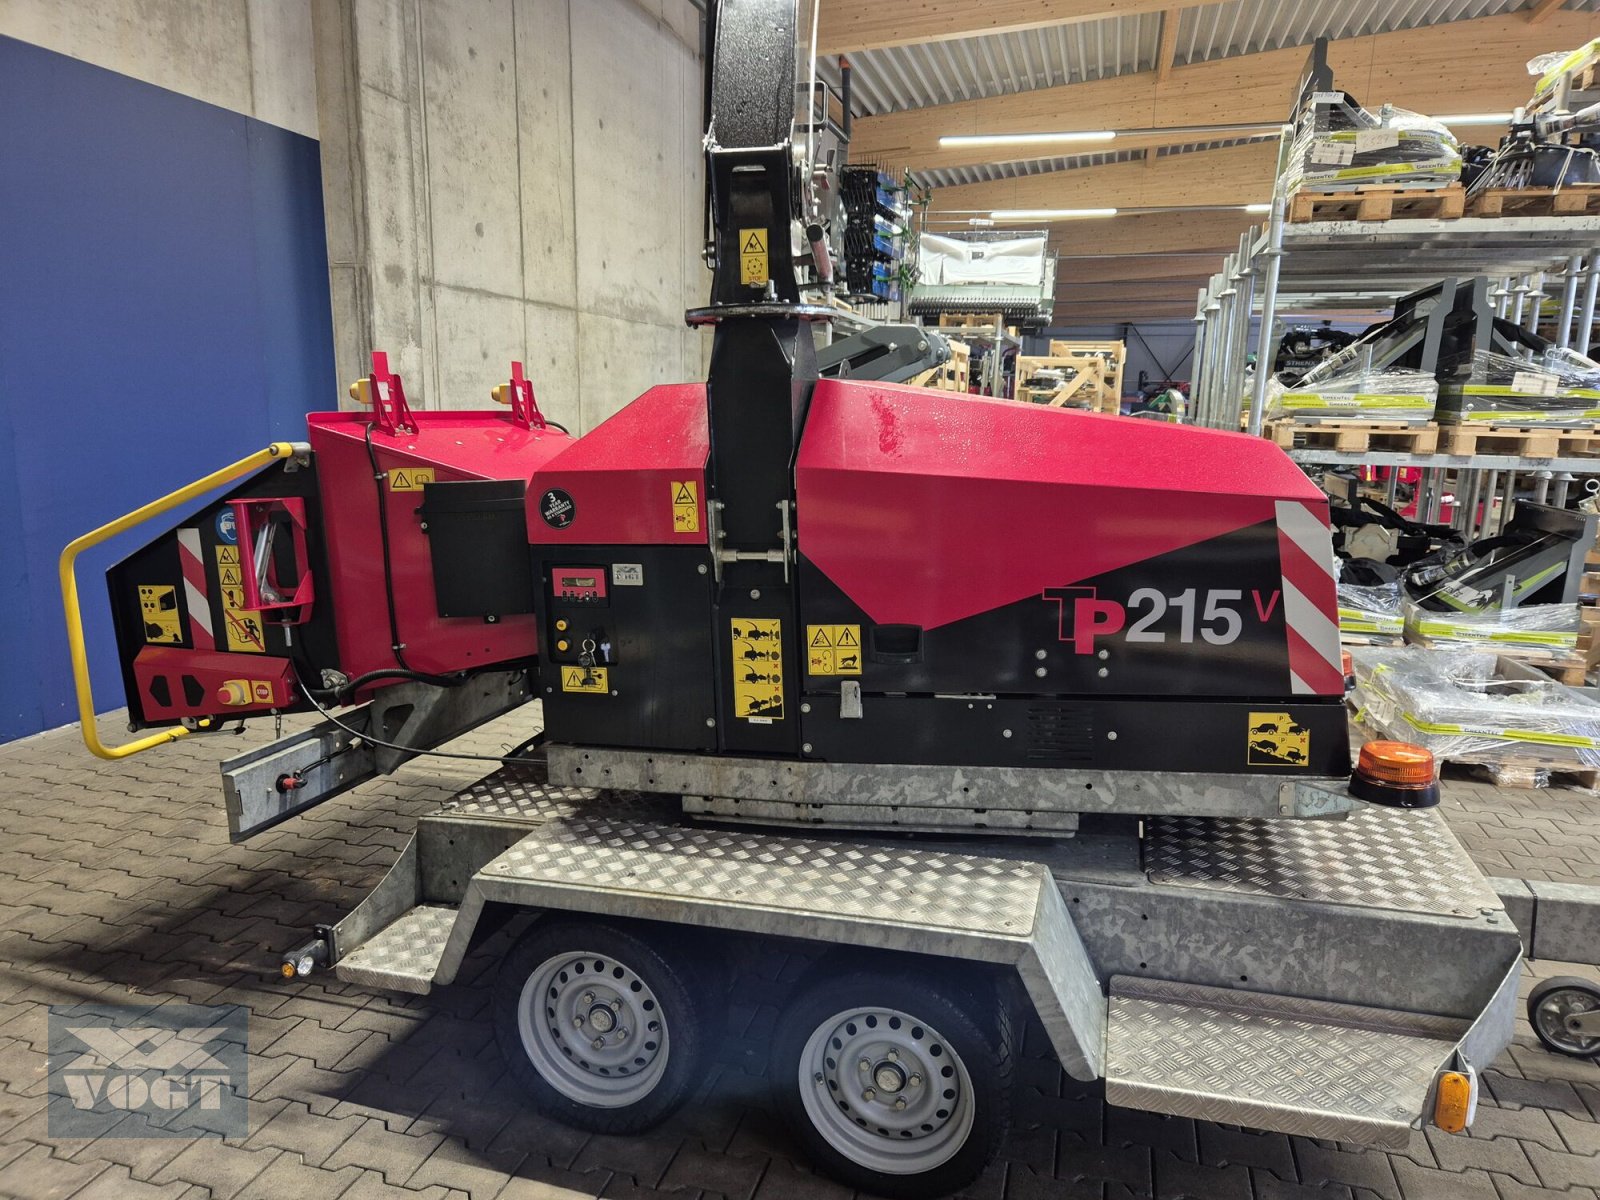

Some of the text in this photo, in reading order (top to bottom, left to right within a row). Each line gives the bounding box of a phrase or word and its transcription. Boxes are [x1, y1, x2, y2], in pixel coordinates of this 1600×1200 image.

[547, 492, 556, 503] 3
[544, 500, 571, 517] WARRANTY
[549, 499, 562, 509] YEAR
